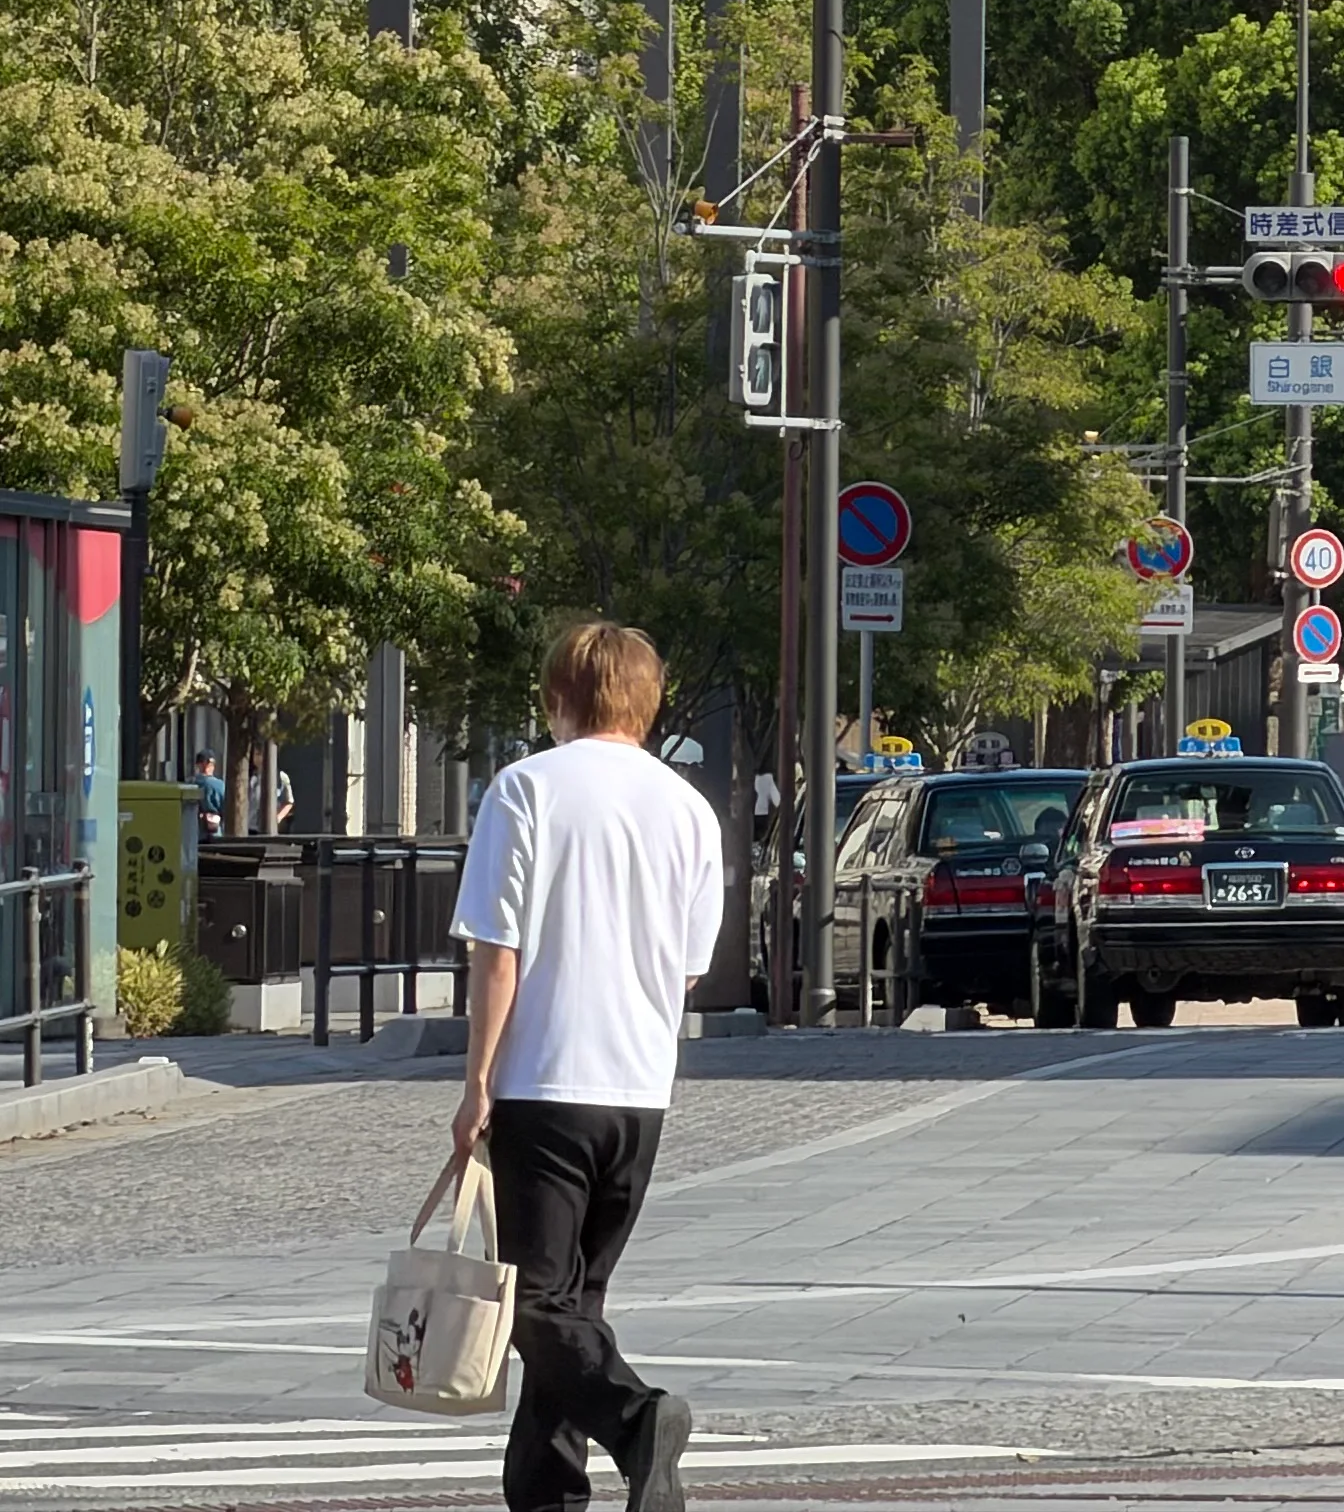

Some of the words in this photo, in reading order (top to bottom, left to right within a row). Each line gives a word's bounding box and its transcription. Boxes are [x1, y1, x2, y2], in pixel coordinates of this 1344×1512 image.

[1267, 380, 1334, 395] Shirogane
[1304, 546, 1332, 571] 40
[1227, 884, 1273, 902] 26-57
